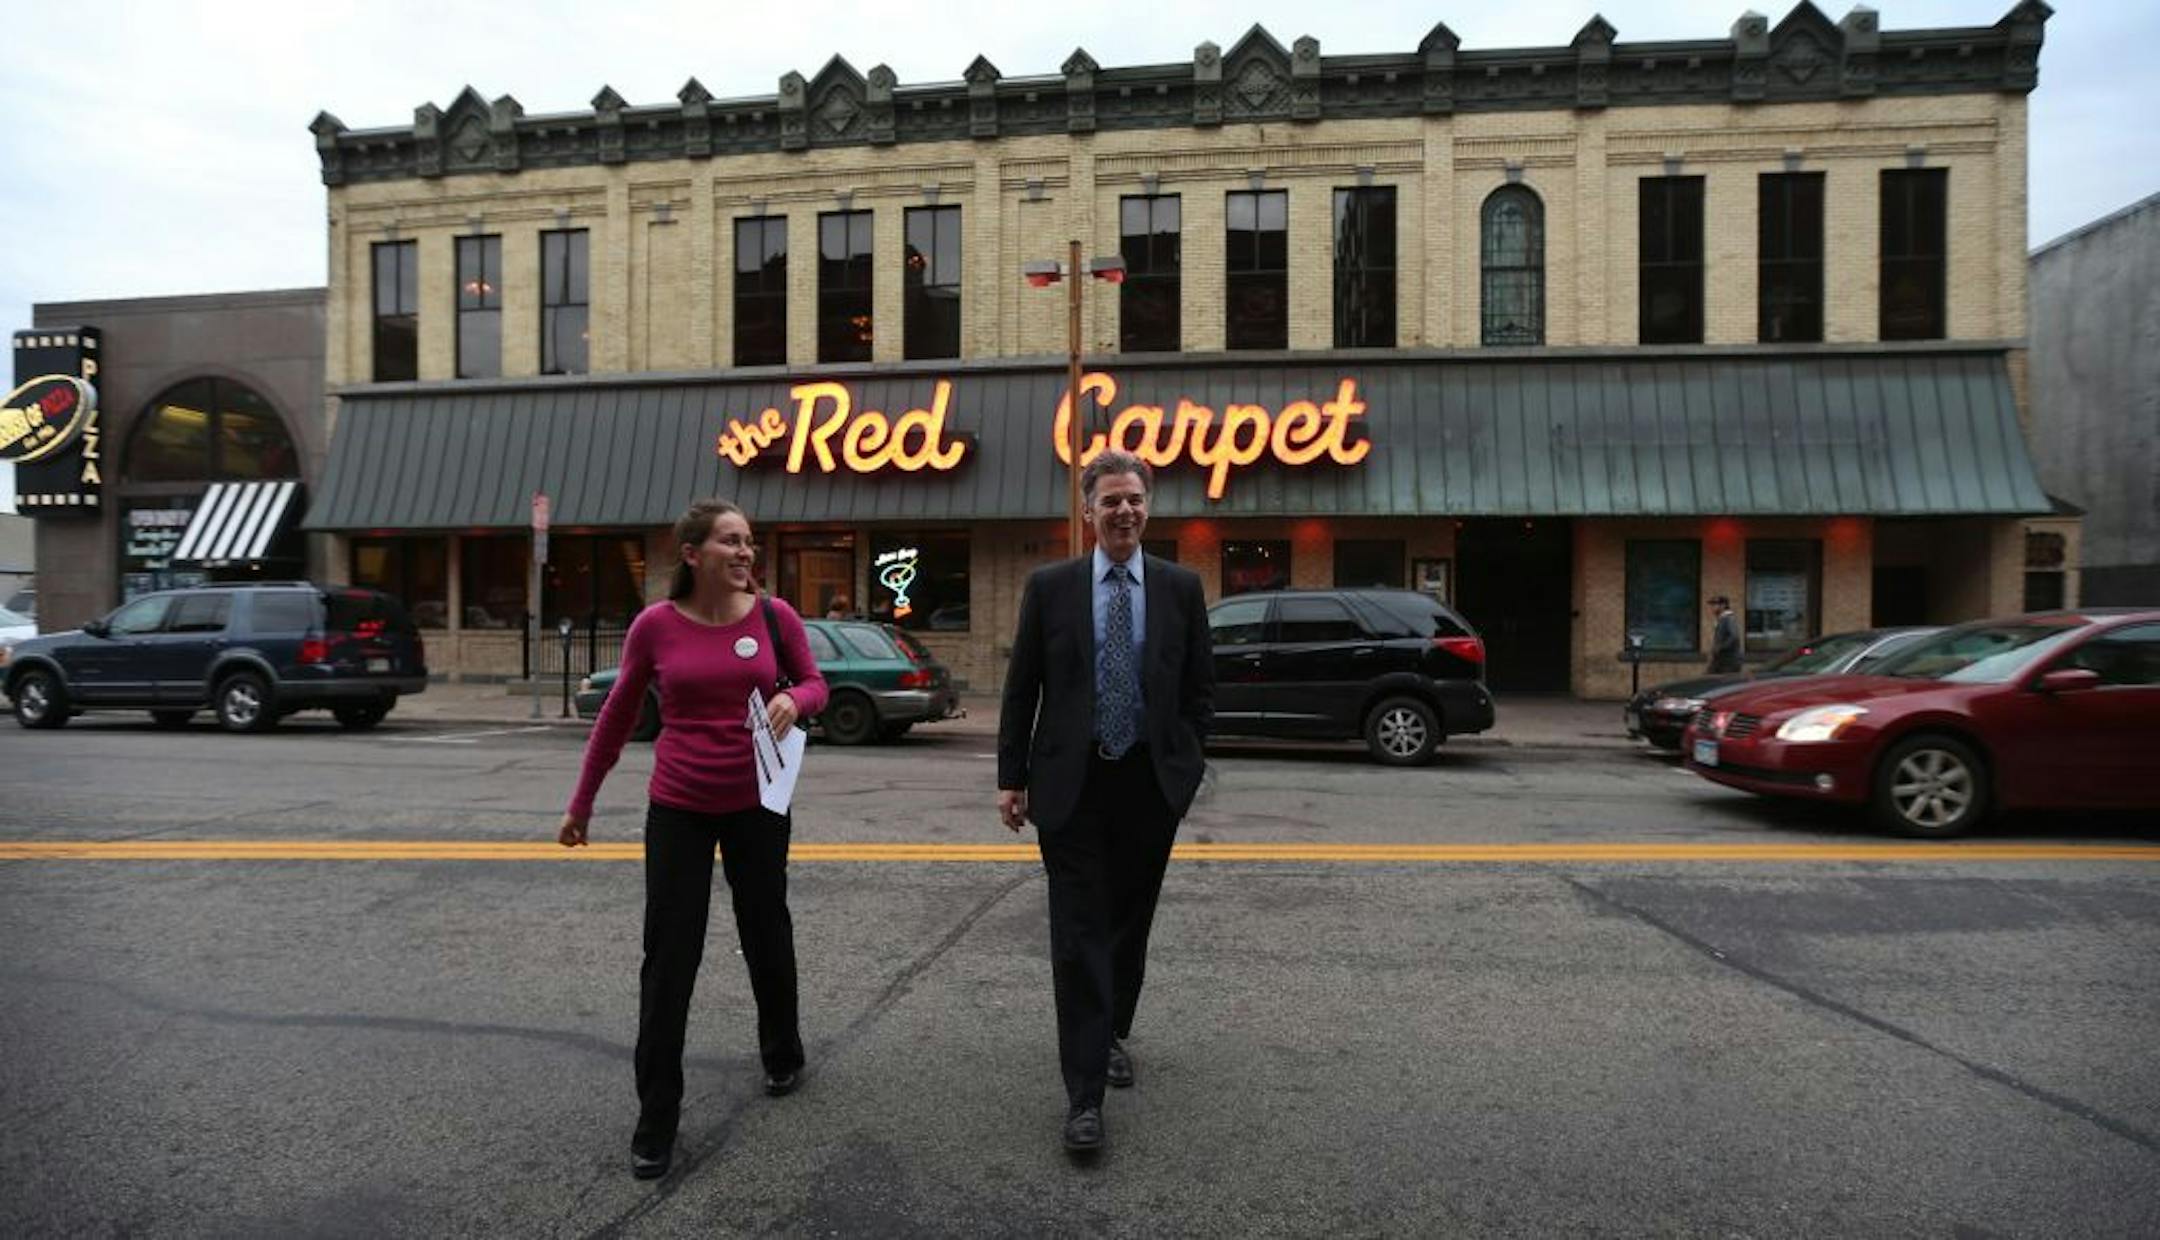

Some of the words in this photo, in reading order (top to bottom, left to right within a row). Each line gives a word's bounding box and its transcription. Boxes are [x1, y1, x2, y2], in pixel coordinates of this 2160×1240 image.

[82, 358, 101, 484] PZZA
[717, 408, 787, 465] the
[787, 380, 966, 472] Red
[1054, 372, 1370, 499] Carpet
